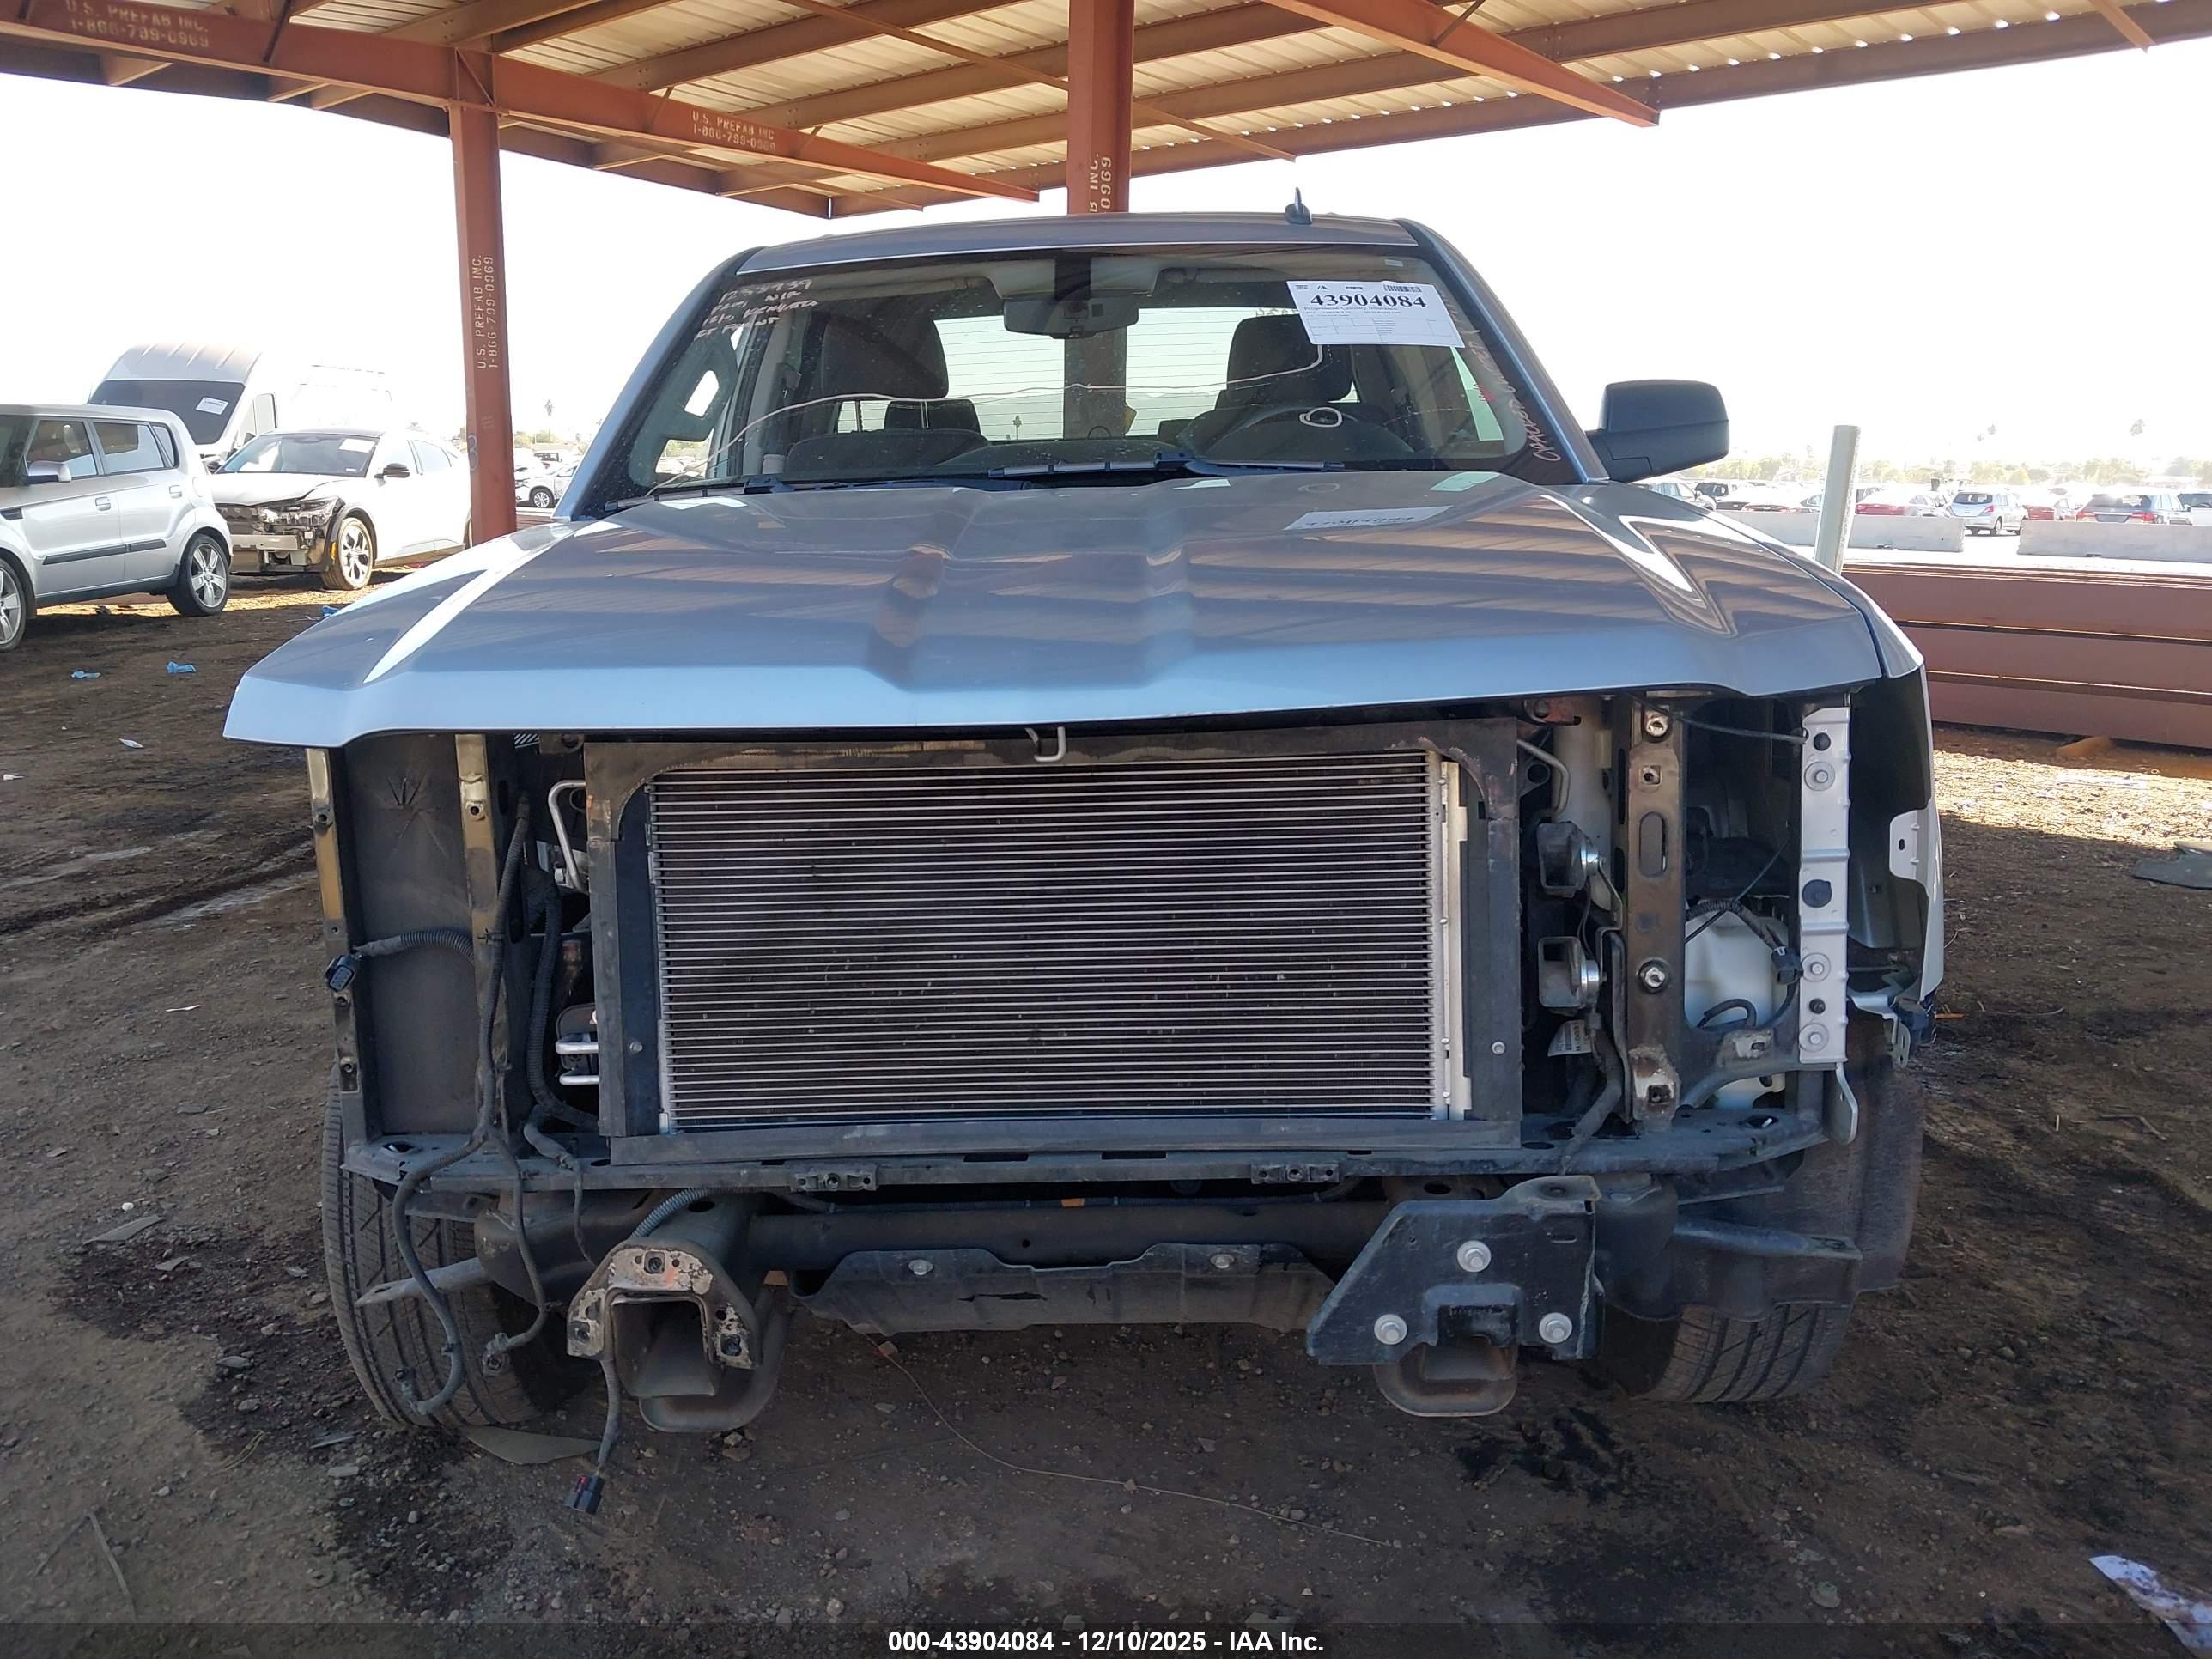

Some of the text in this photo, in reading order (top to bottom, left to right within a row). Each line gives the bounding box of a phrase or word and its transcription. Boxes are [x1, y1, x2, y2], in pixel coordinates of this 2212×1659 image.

[106, 4, 171, 27] PREFAB
[717, 117, 755, 135] PREFAB
[1089, 153, 1099, 190] INC.
[471, 254, 487, 368] U.S. PREFAB INC.
[483, 257, 499, 368] 1-866-799-0969
[1310, 294, 1427, 307] 43904084
